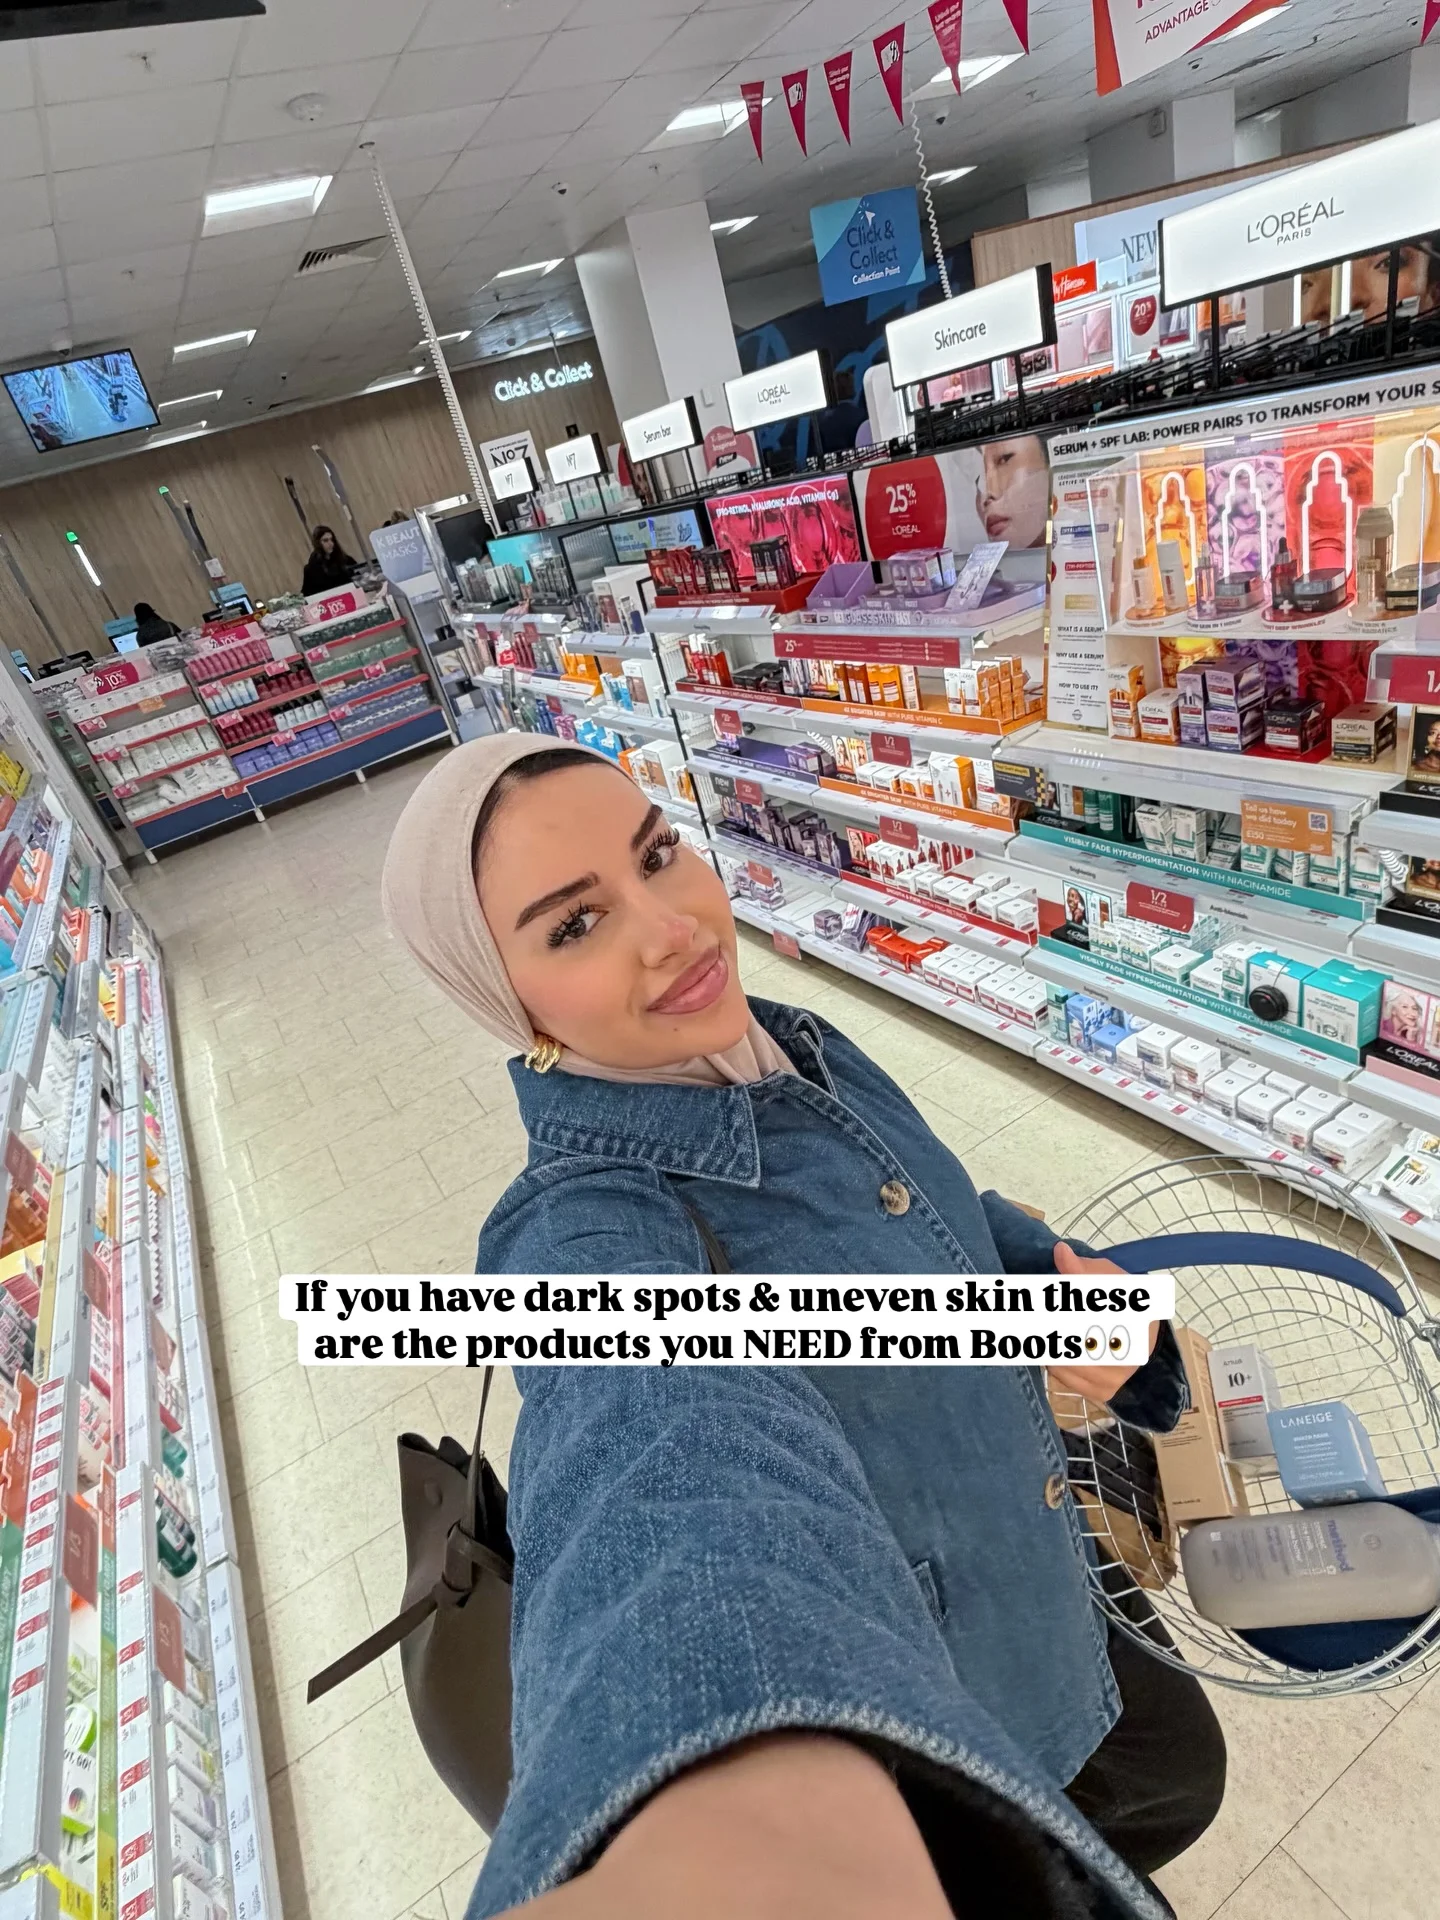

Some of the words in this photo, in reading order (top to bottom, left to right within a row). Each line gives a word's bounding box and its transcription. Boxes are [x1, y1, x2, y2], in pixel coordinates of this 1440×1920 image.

[1145, 3, 1209, 43] ADVANTAGE
[1247, 197, 1344, 243] L'ORÉAL
[847, 224, 882, 248] Click
[884, 220, 895, 239] &
[1277, 227, 1311, 246] PARIS
[850, 244, 898, 270] Collect
[852, 270, 885, 285] Collection
[885, 266, 900, 277] Point
[934, 322, 987, 350] Skincare
[494, 376, 531, 401] Click
[530, 372, 545, 392] &
[544, 361, 593, 388] Collect
[1053, 441, 1088, 456] SERUM
[1091, 440, 1097, 449] +
[1100, 436, 1120, 449] SPF
[1123, 431, 1150, 444] LAB:
[1153, 422, 1200, 440] POWER
[1203, 414, 1243, 431] PAIRS
[1247, 410, 1267, 424] TO
[1271, 392, 1370, 420] TRANSFORM
[1375, 382, 1426, 403] YOUR
[644, 429, 662, 443] Serum
[661, 425, 672, 437] bar
[802, 491, 826, 504] VITAMIN
[885, 483, 916, 513] 25%
[386, 526, 420, 546] BEAUT
[381, 542, 418, 560] MASKS
[1244, 802, 1257, 812] Tell
[1269, 806, 1286, 815] how
[1258, 814, 1271, 823] did
[1273, 816, 1297, 828] today
[1063, 836, 1090, 848] VISIBLY
[1092, 842, 1111, 853] FADE
[1112, 847, 1200, 875] HYPERPIGMENTATION
[1201, 869, 1225, 882] WITH
[1226, 875, 1292, 898] NIACINAMIDE
[1151, 889, 1167, 901] 1/2
[1079, 953, 1105, 967] VISIBLY
[1105, 961, 1125, 974] FADE
[1125, 968, 1208, 1006] HYPERPIGMENTATION
[1209, 999, 1232, 1014] WITH
[1280, 1411, 1333, 1428] LANEIGE
[1327, 1519, 1355, 1573] method
